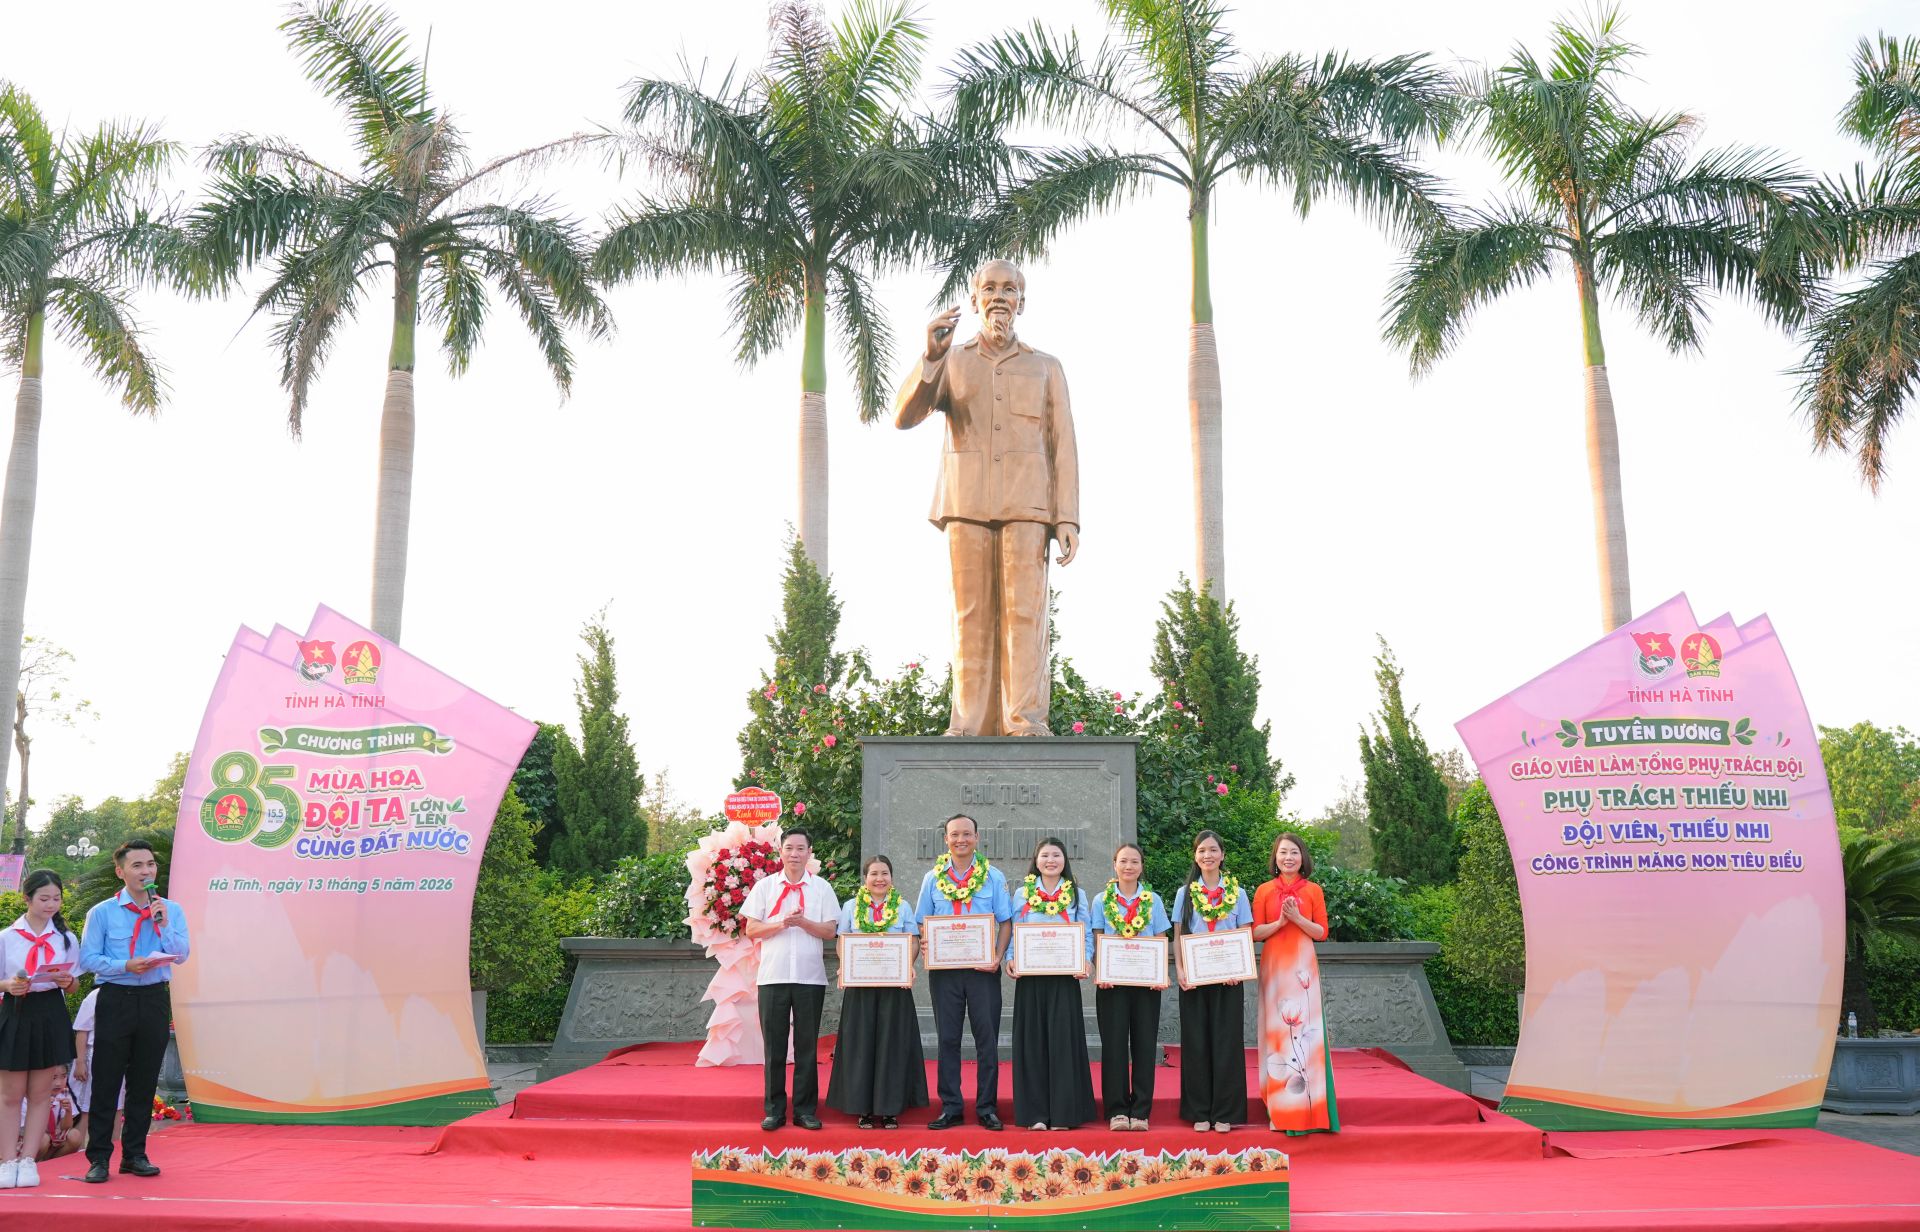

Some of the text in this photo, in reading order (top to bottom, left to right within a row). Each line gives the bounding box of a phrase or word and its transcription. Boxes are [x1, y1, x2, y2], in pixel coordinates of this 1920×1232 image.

[285, 692, 386, 708] TỈNH HÀ TĨNH
[1628, 686, 1734, 702] TỈNH HÀ TĨNH
[297, 731, 415, 750] CHƯƠNG TRÌNH
[1591, 720, 1722, 742] TUYÊN DƯƠNG
[1511, 752, 1803, 777] GIÁO VIÊN LÀM TỔNG PHỤ TRÁCH ĐỘI
[309, 768, 422, 790] MÙA HOA
[200, 751, 302, 848] 85
[961, 775, 1041, 811] CHỦ TỊCH
[1544, 781, 1787, 812] PHỤ TRÁCH THIẾU NHI
[268, 808, 284, 818] 15.5
[305, 795, 405, 834] ĐỘI TA
[410, 797, 444, 813] LỚN
[416, 812, 447, 826] LÊN
[296, 827, 469, 856] CÙNG ĐẤT NƯỚC
[1563, 817, 1769, 845] ĐỘI VIÊN, THIẾU NHI
[1532, 850, 1803, 871] CÔNG TRÌNH MĂNG NON TIÊU BIỂU
[209, 878, 453, 893] Hà Tĩnh, ngày 13 tháng 5 năm 2026
